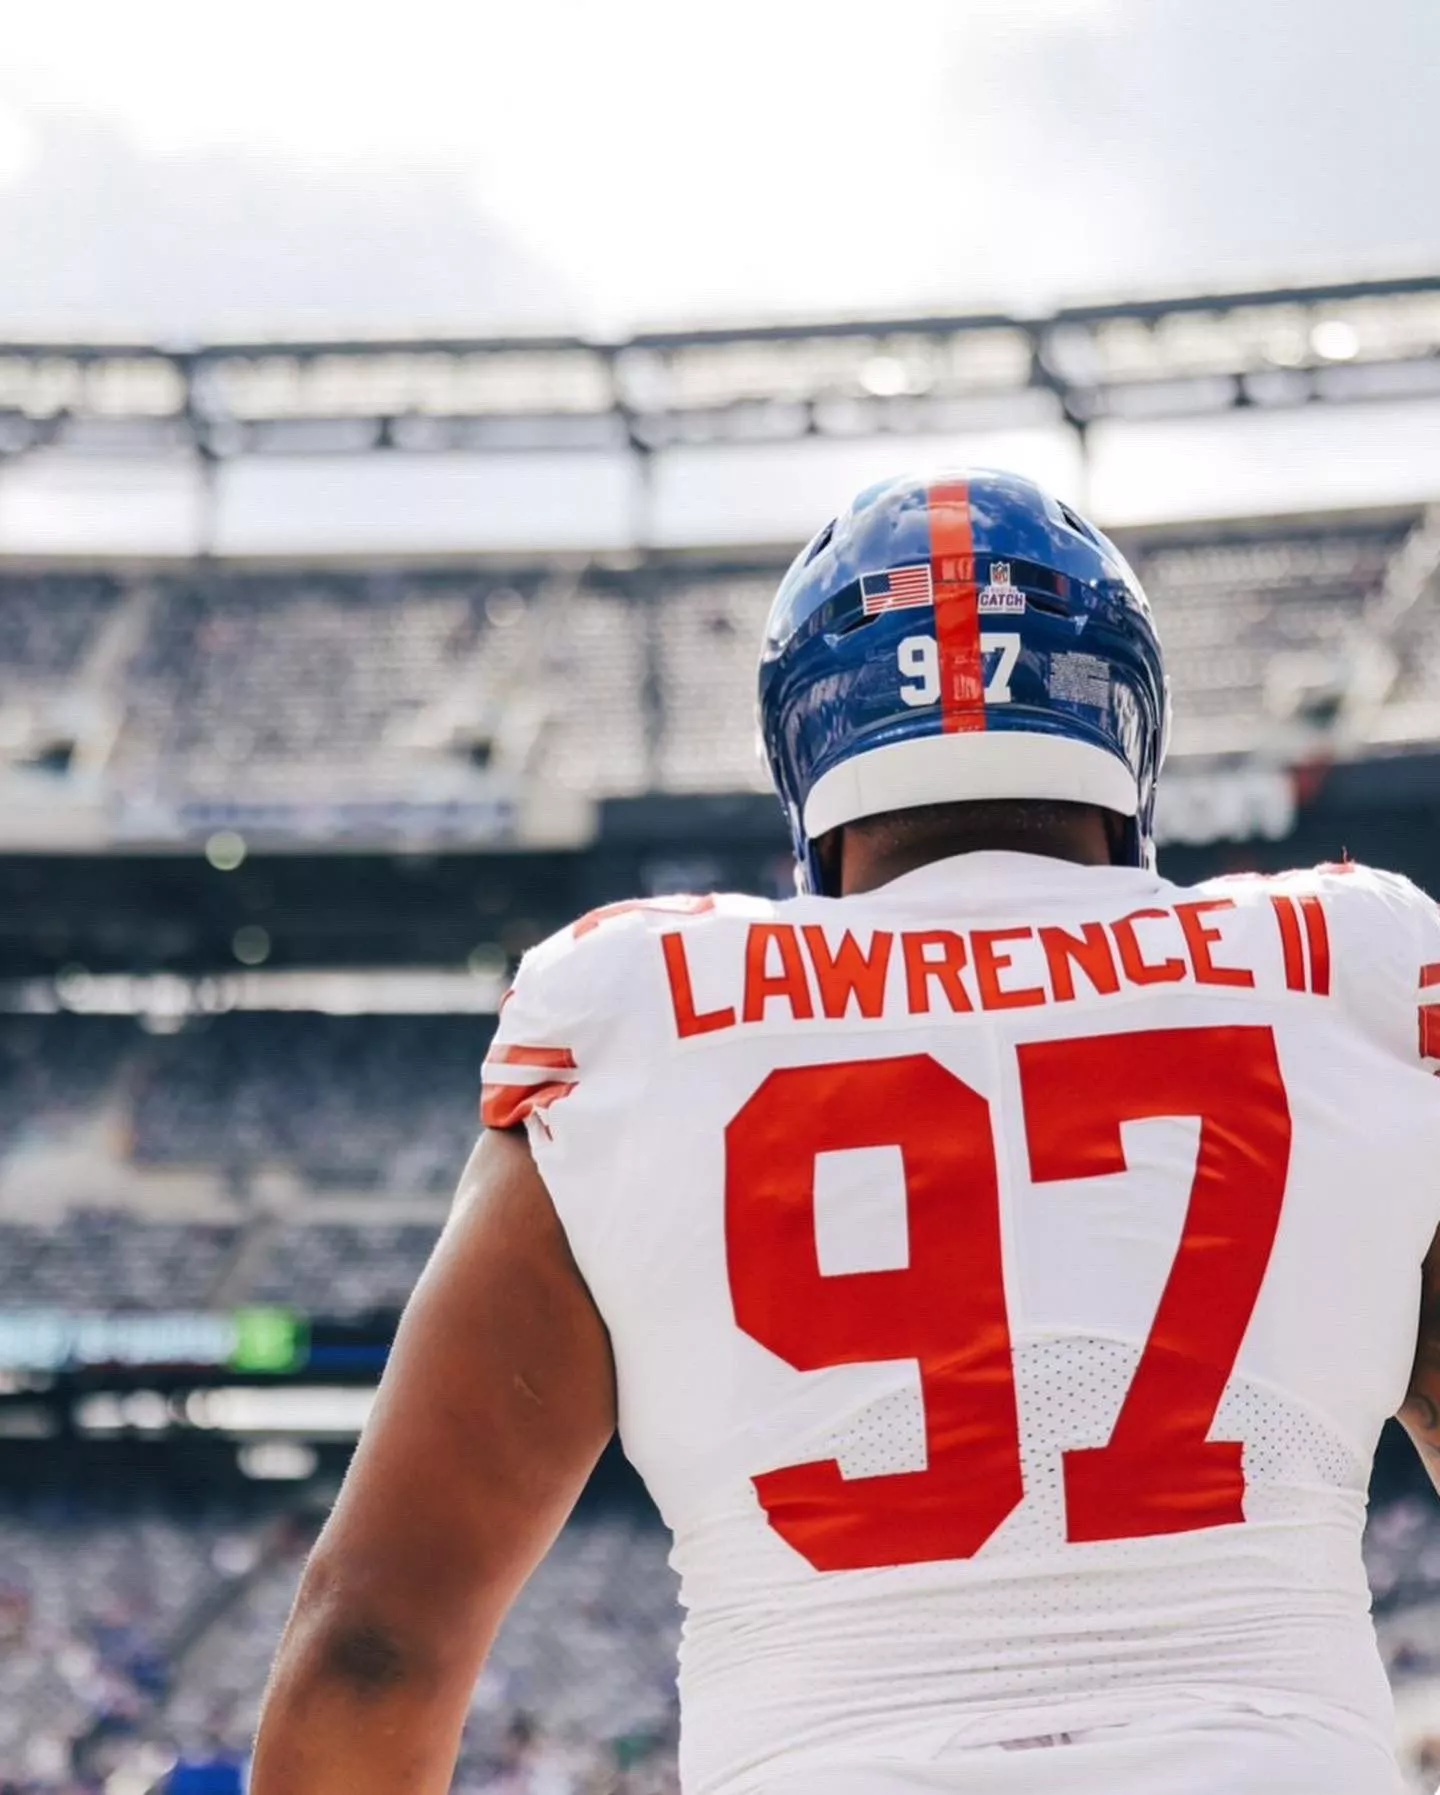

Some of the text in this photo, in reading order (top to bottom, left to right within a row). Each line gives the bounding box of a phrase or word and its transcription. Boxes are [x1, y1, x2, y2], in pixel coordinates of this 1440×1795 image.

[980, 593, 1023, 606] CATCH
[662, 897, 1330, 1038] LAWRENCE II
[725, 1025, 1292, 1572] 97
